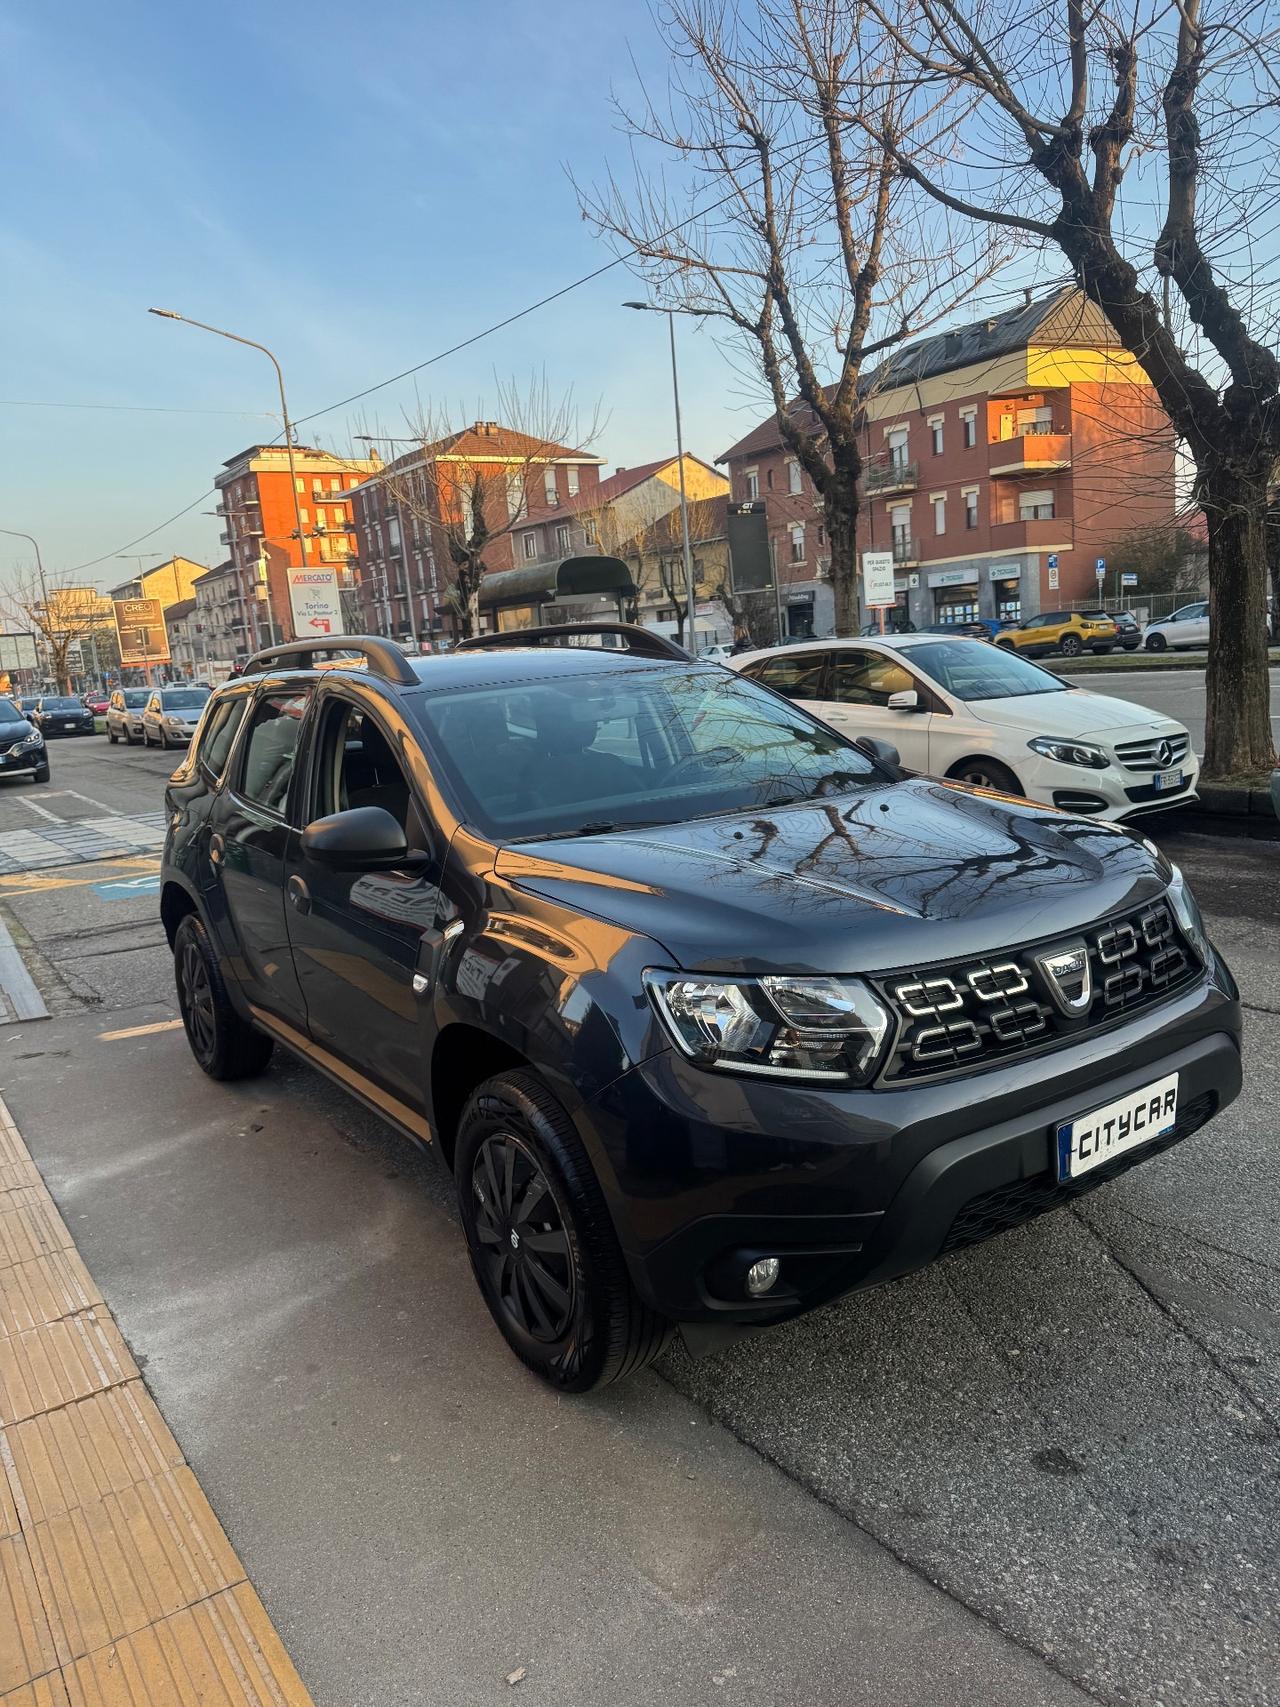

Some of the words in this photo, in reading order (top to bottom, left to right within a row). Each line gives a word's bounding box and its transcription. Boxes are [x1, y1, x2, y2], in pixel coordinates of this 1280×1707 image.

[1097, 559, 1104, 568] P
[293, 574, 333, 583] MERCATO
[125, 603, 151, 612] CREO
[1078, 1088, 1176, 1161] CITYCAR
